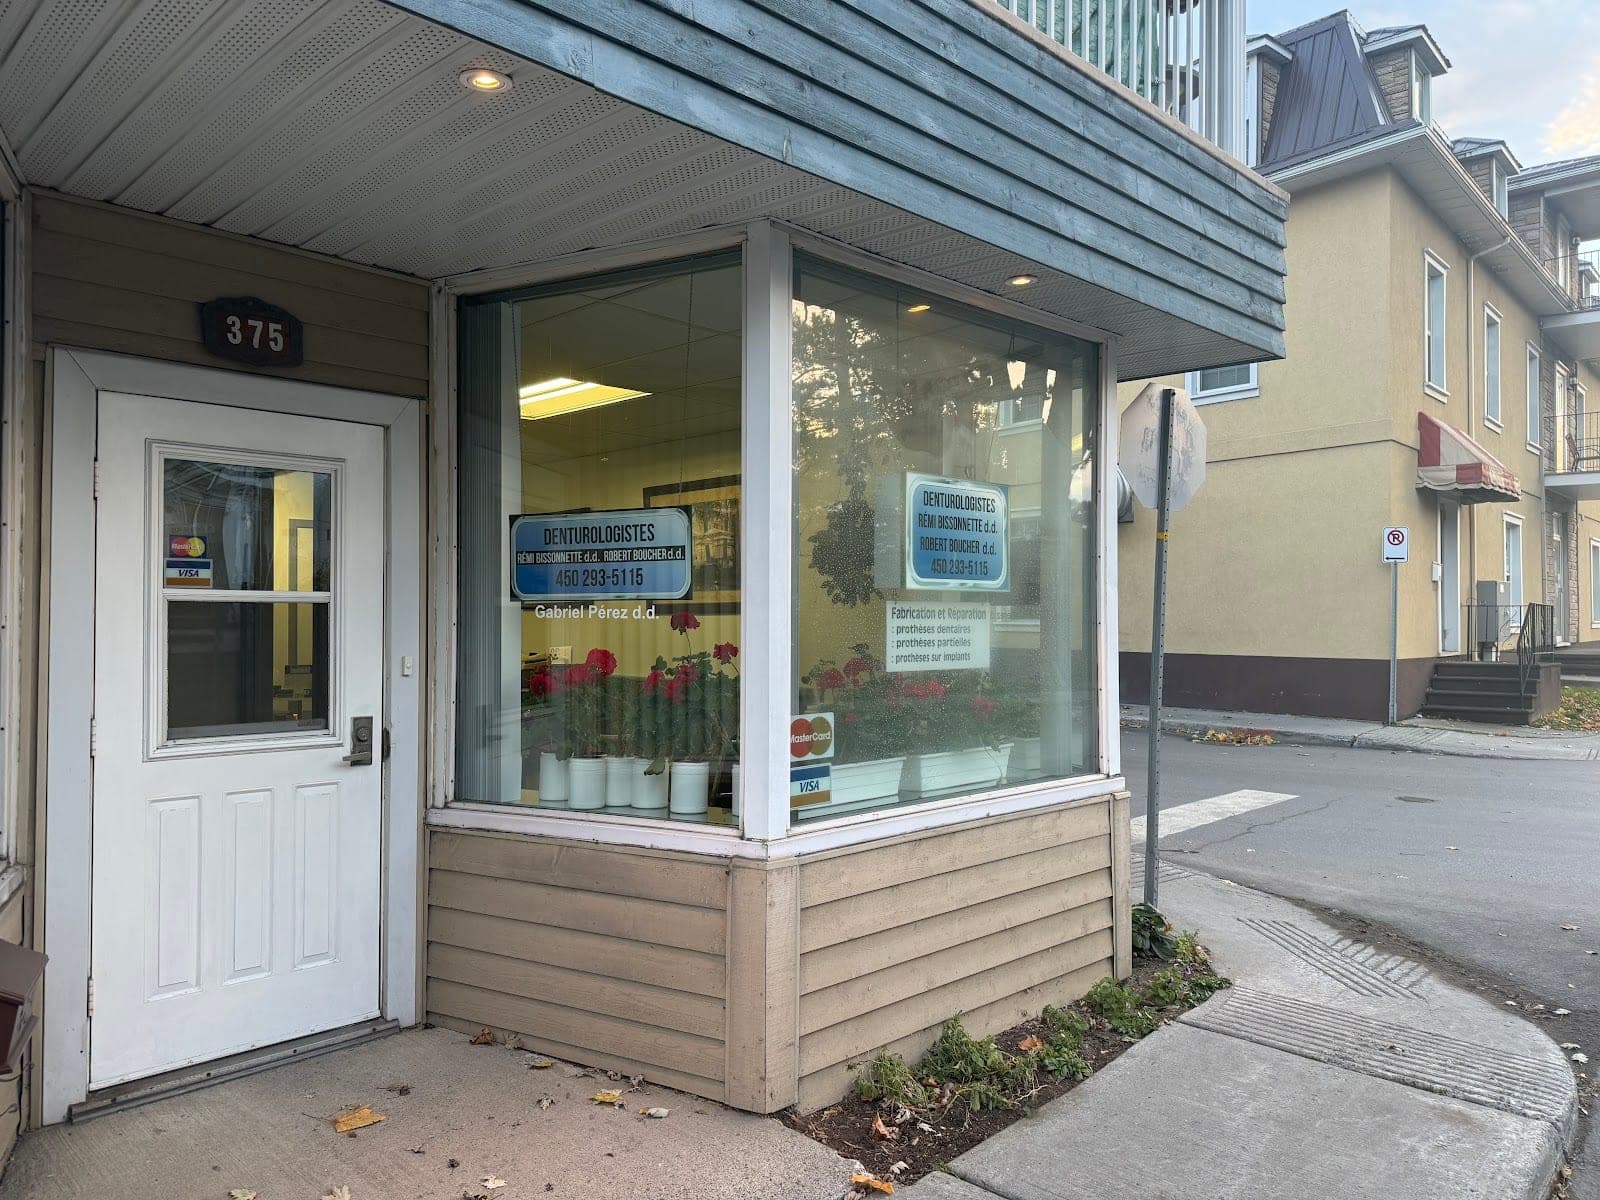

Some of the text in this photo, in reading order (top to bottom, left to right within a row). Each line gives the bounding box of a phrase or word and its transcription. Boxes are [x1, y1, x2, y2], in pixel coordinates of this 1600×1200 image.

[226, 315, 284, 352] 375
[923, 490, 996, 513] DENTUROLOGISTES
[918, 511, 937, 529] RÉMI
[938, 515, 983, 533] BISSONNETTE
[544, 523, 655, 545] DENTUROLOGISTES
[920, 536, 947, 552] ROBERT
[949, 538, 980, 554] BOUCHER
[517, 552, 535, 564] RÉMI
[536, 551, 582, 564] BISSONNETTE
[604, 550, 632, 562] ROBERT
[633, 548, 667, 561] BOUCHER
[178, 569, 199, 578] VISA
[931, 558, 989, 576] 450 293-5115
[556, 567, 644, 587] 450 293-5115
[535, 605, 660, 619] Gabriel Pérez d.d.
[891, 606, 987, 621] Fabrication et Réparation
[896, 624, 935, 635] prothèses
[936, 624, 971, 635] dentaires
[896, 638, 935, 650] prothèses
[936, 637, 971, 649] partielles
[931, 653, 942, 662] sur
[943, 651, 971, 662] implants
[800, 780, 819, 792] VISA
